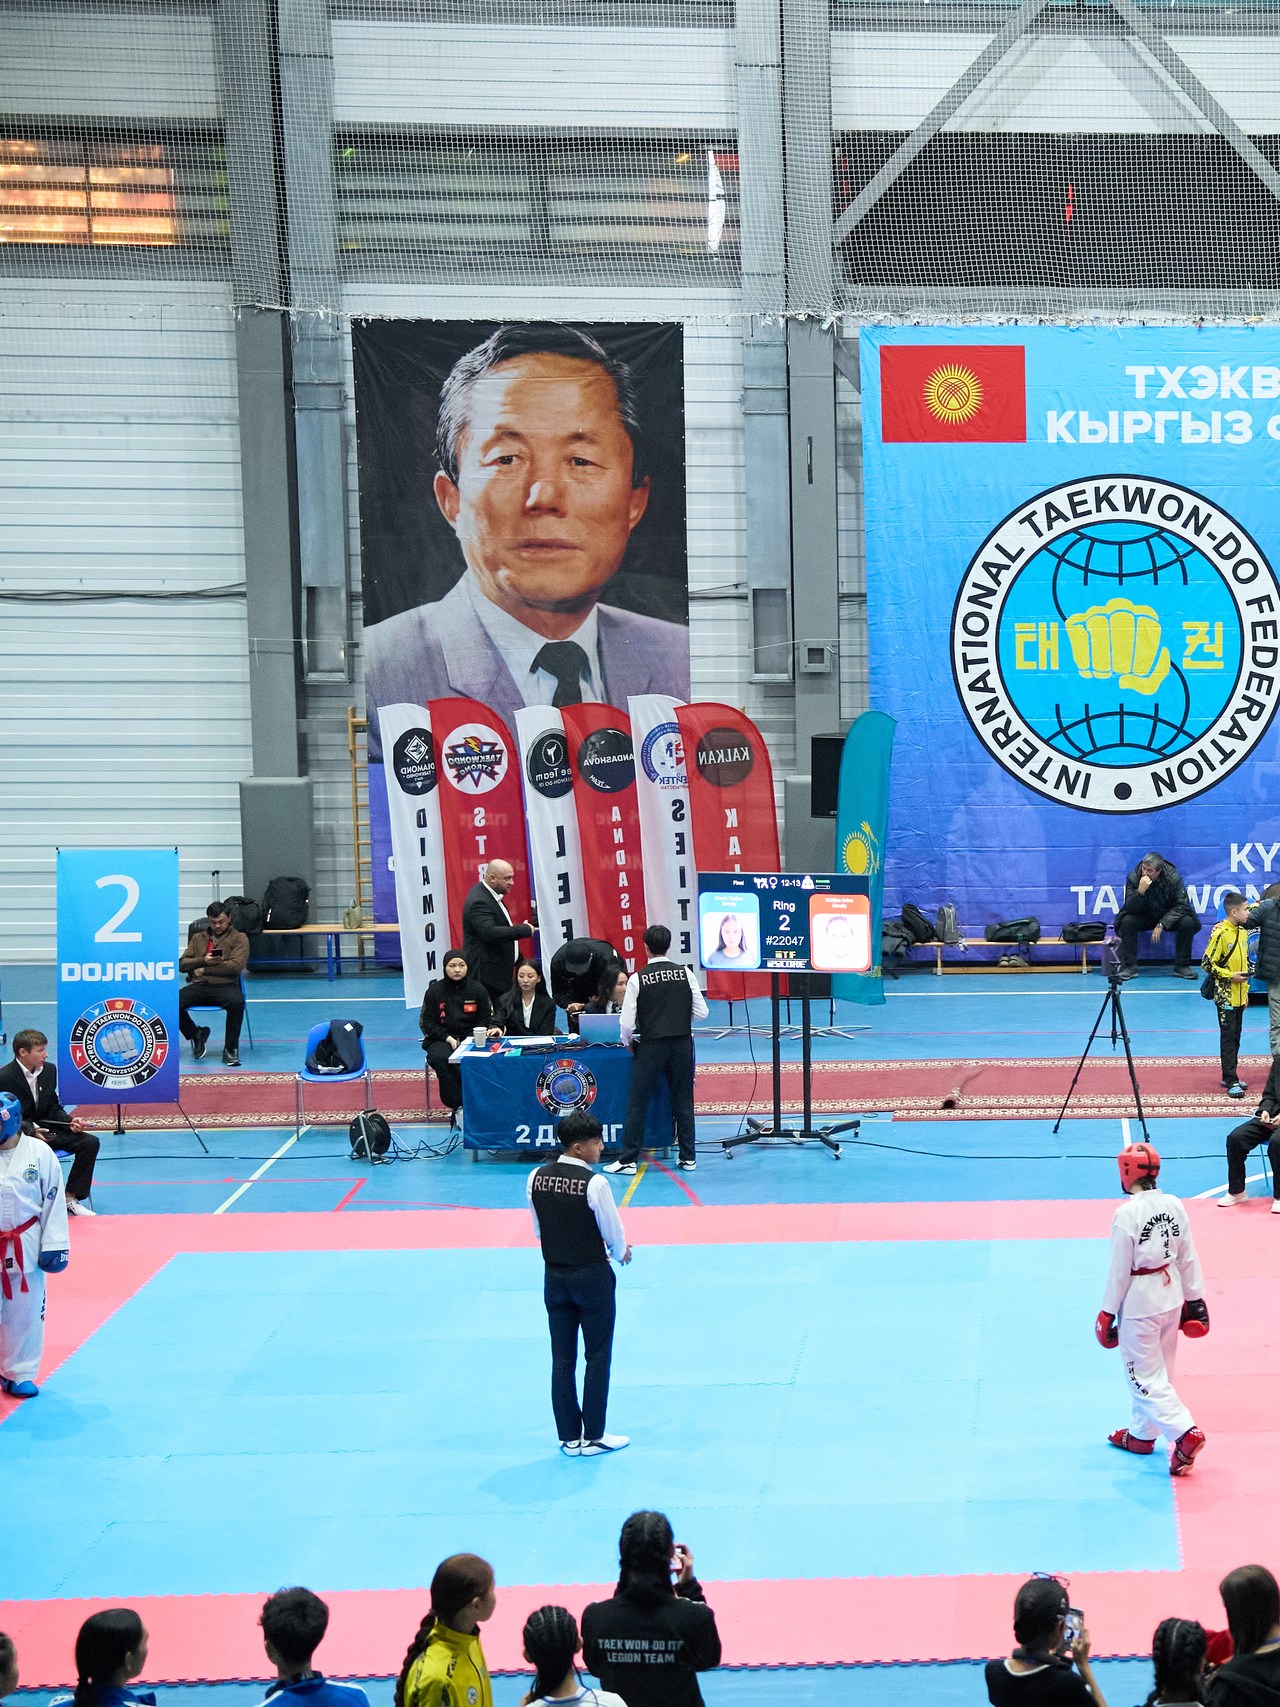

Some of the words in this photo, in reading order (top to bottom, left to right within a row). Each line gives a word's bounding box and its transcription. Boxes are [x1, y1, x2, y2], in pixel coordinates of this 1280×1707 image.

[1047, 411, 1252, 444] КЫРГЫЗ
[1018, 484, 1260, 587] TAEKWON-DO
[1014, 622, 1060, 671] 태
[1183, 621, 1223, 670] 권
[961, 541, 1093, 800] INTERNATIONAL
[1151, 592, 1278, 798] FEDERATION
[781, 879, 801, 887] 12-13
[94, 874, 142, 943] 2
[773, 901, 795, 912] Ring
[779, 915, 791, 931] 2
[766, 936, 805, 946] #22047
[61, 961, 175, 982] DOJANG
[641, 970, 686, 986] REFEREE
[515, 1124, 531, 1144] 2
[535, 1124, 623, 1147] ДНГ
[534, 1175, 586, 1196] REFEREE
[607, 1652, 641, 1663] LEGION
[644, 1653, 675, 1663] TEAM
